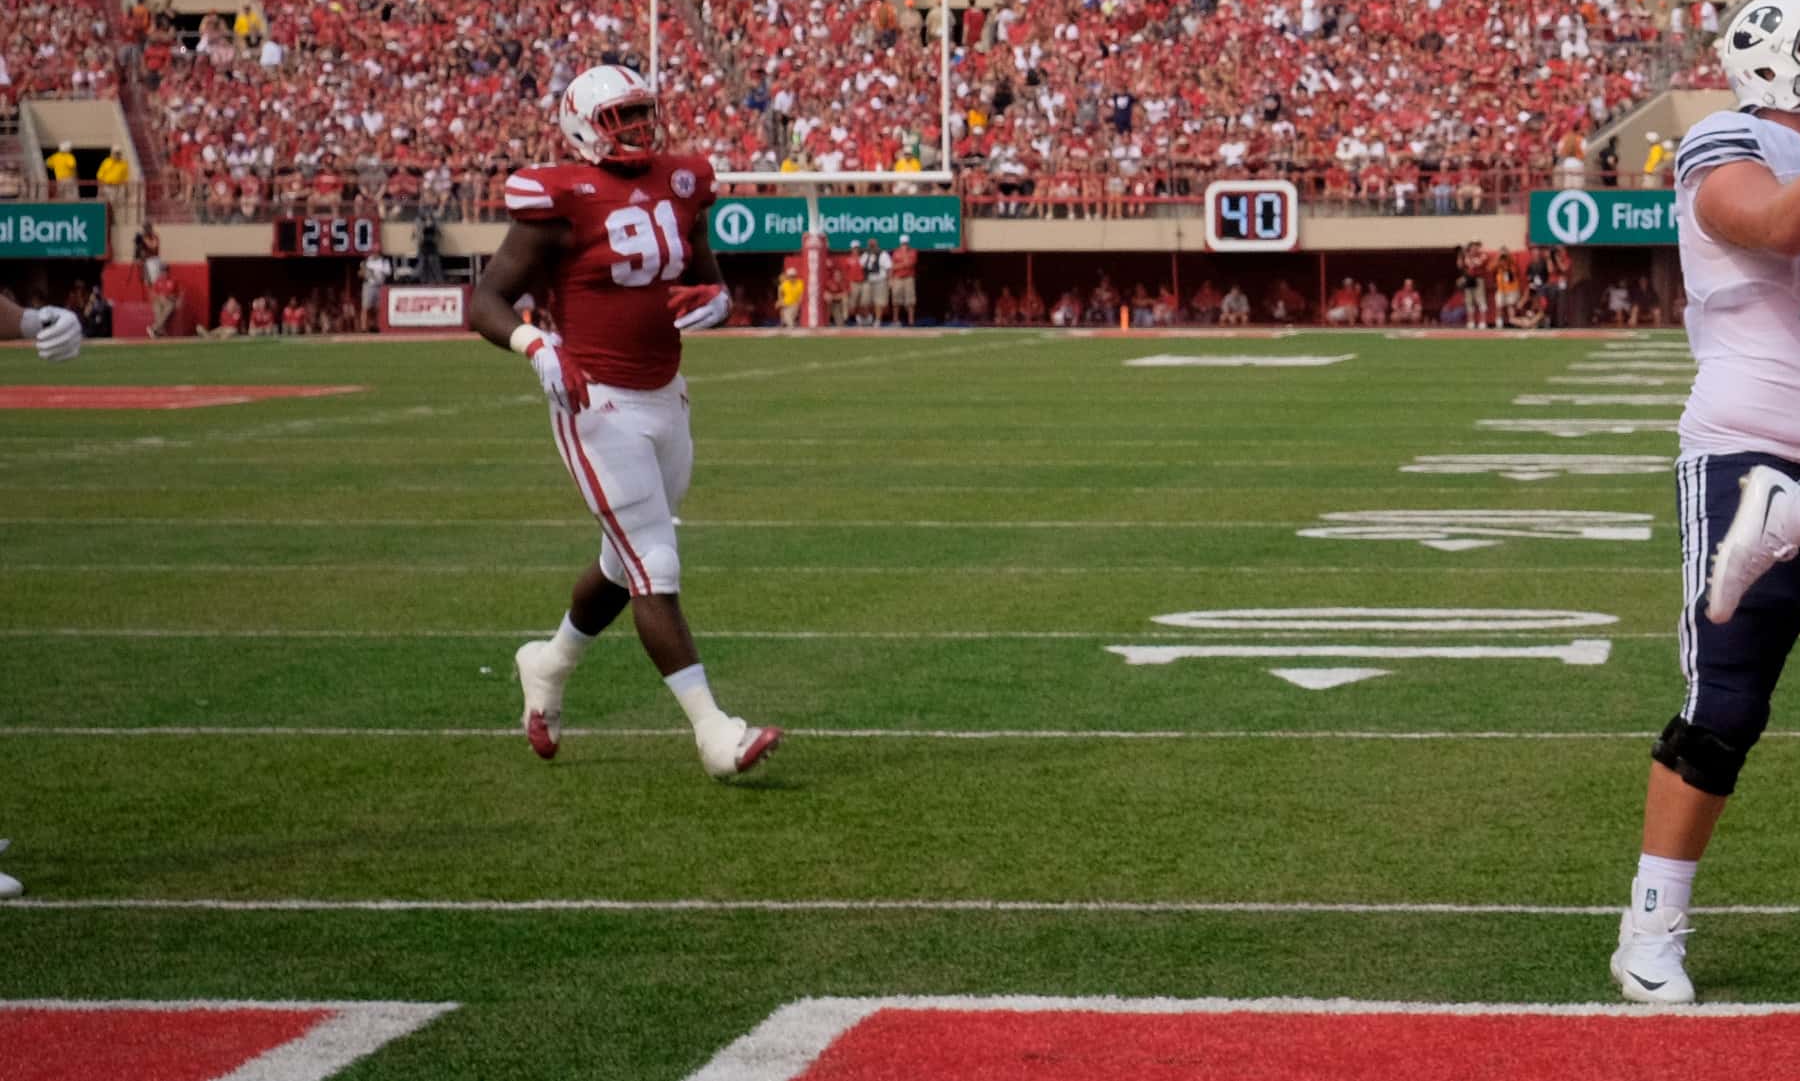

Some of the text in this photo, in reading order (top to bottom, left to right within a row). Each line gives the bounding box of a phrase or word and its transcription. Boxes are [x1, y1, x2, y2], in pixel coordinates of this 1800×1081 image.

[19, 215, 89, 243] Bank
[764, 213, 804, 234] First
[814, 212, 900, 234] ational
[902, 212, 956, 234] Bank
[1221, 192, 1282, 239] 40
[1611, 201, 1664, 231] First
[302, 217, 374, 256] 2:50
[605, 200, 686, 287] 91
[395, 295, 458, 314] ESPN
